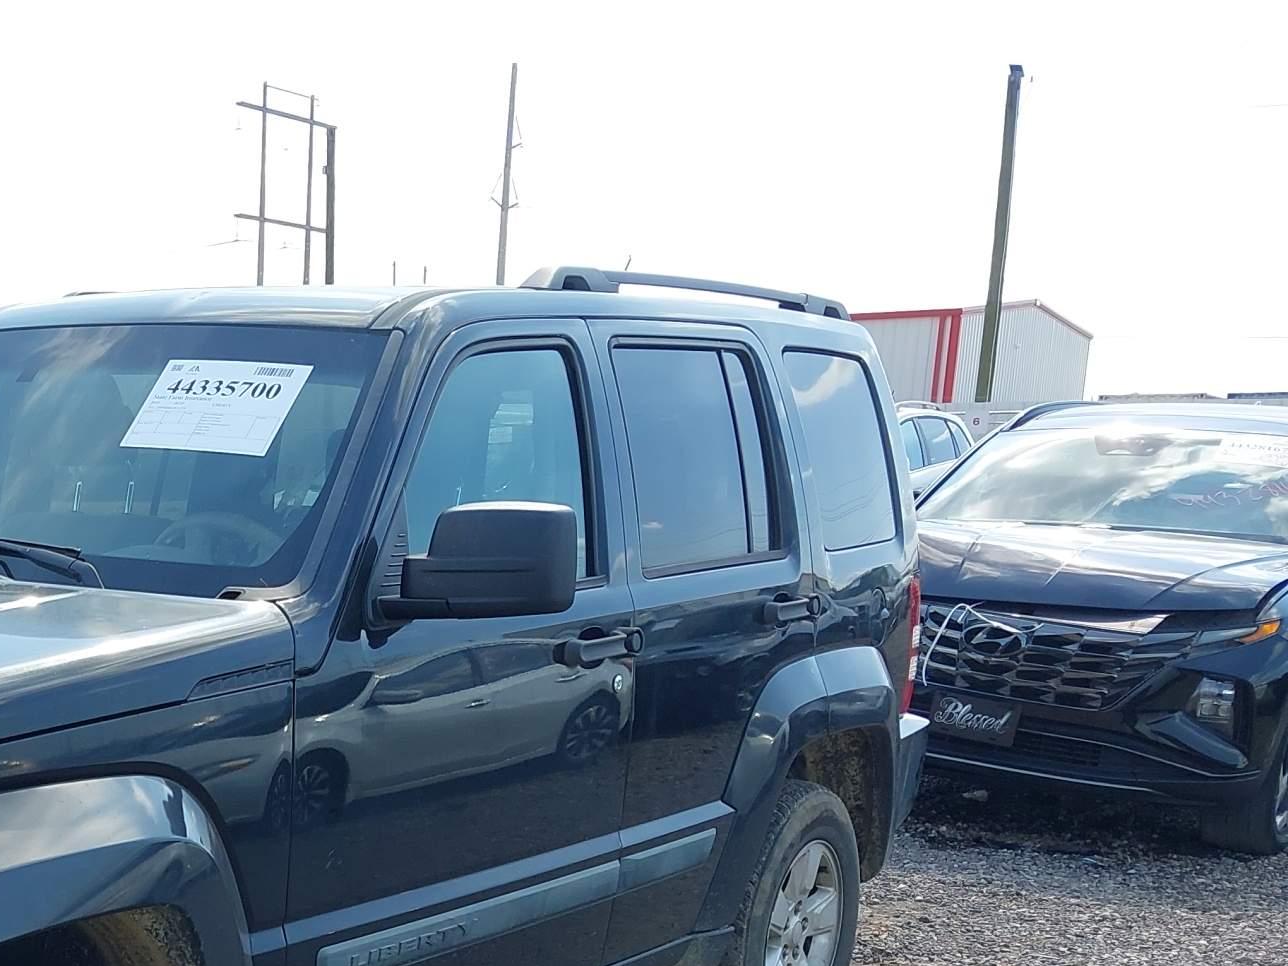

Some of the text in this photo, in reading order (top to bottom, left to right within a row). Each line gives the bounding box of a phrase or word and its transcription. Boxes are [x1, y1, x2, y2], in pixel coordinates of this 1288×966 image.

[167, 378, 282, 400] 44335700
[972, 417, 981, 426] 6
[934, 696, 1013, 734] Blessed
